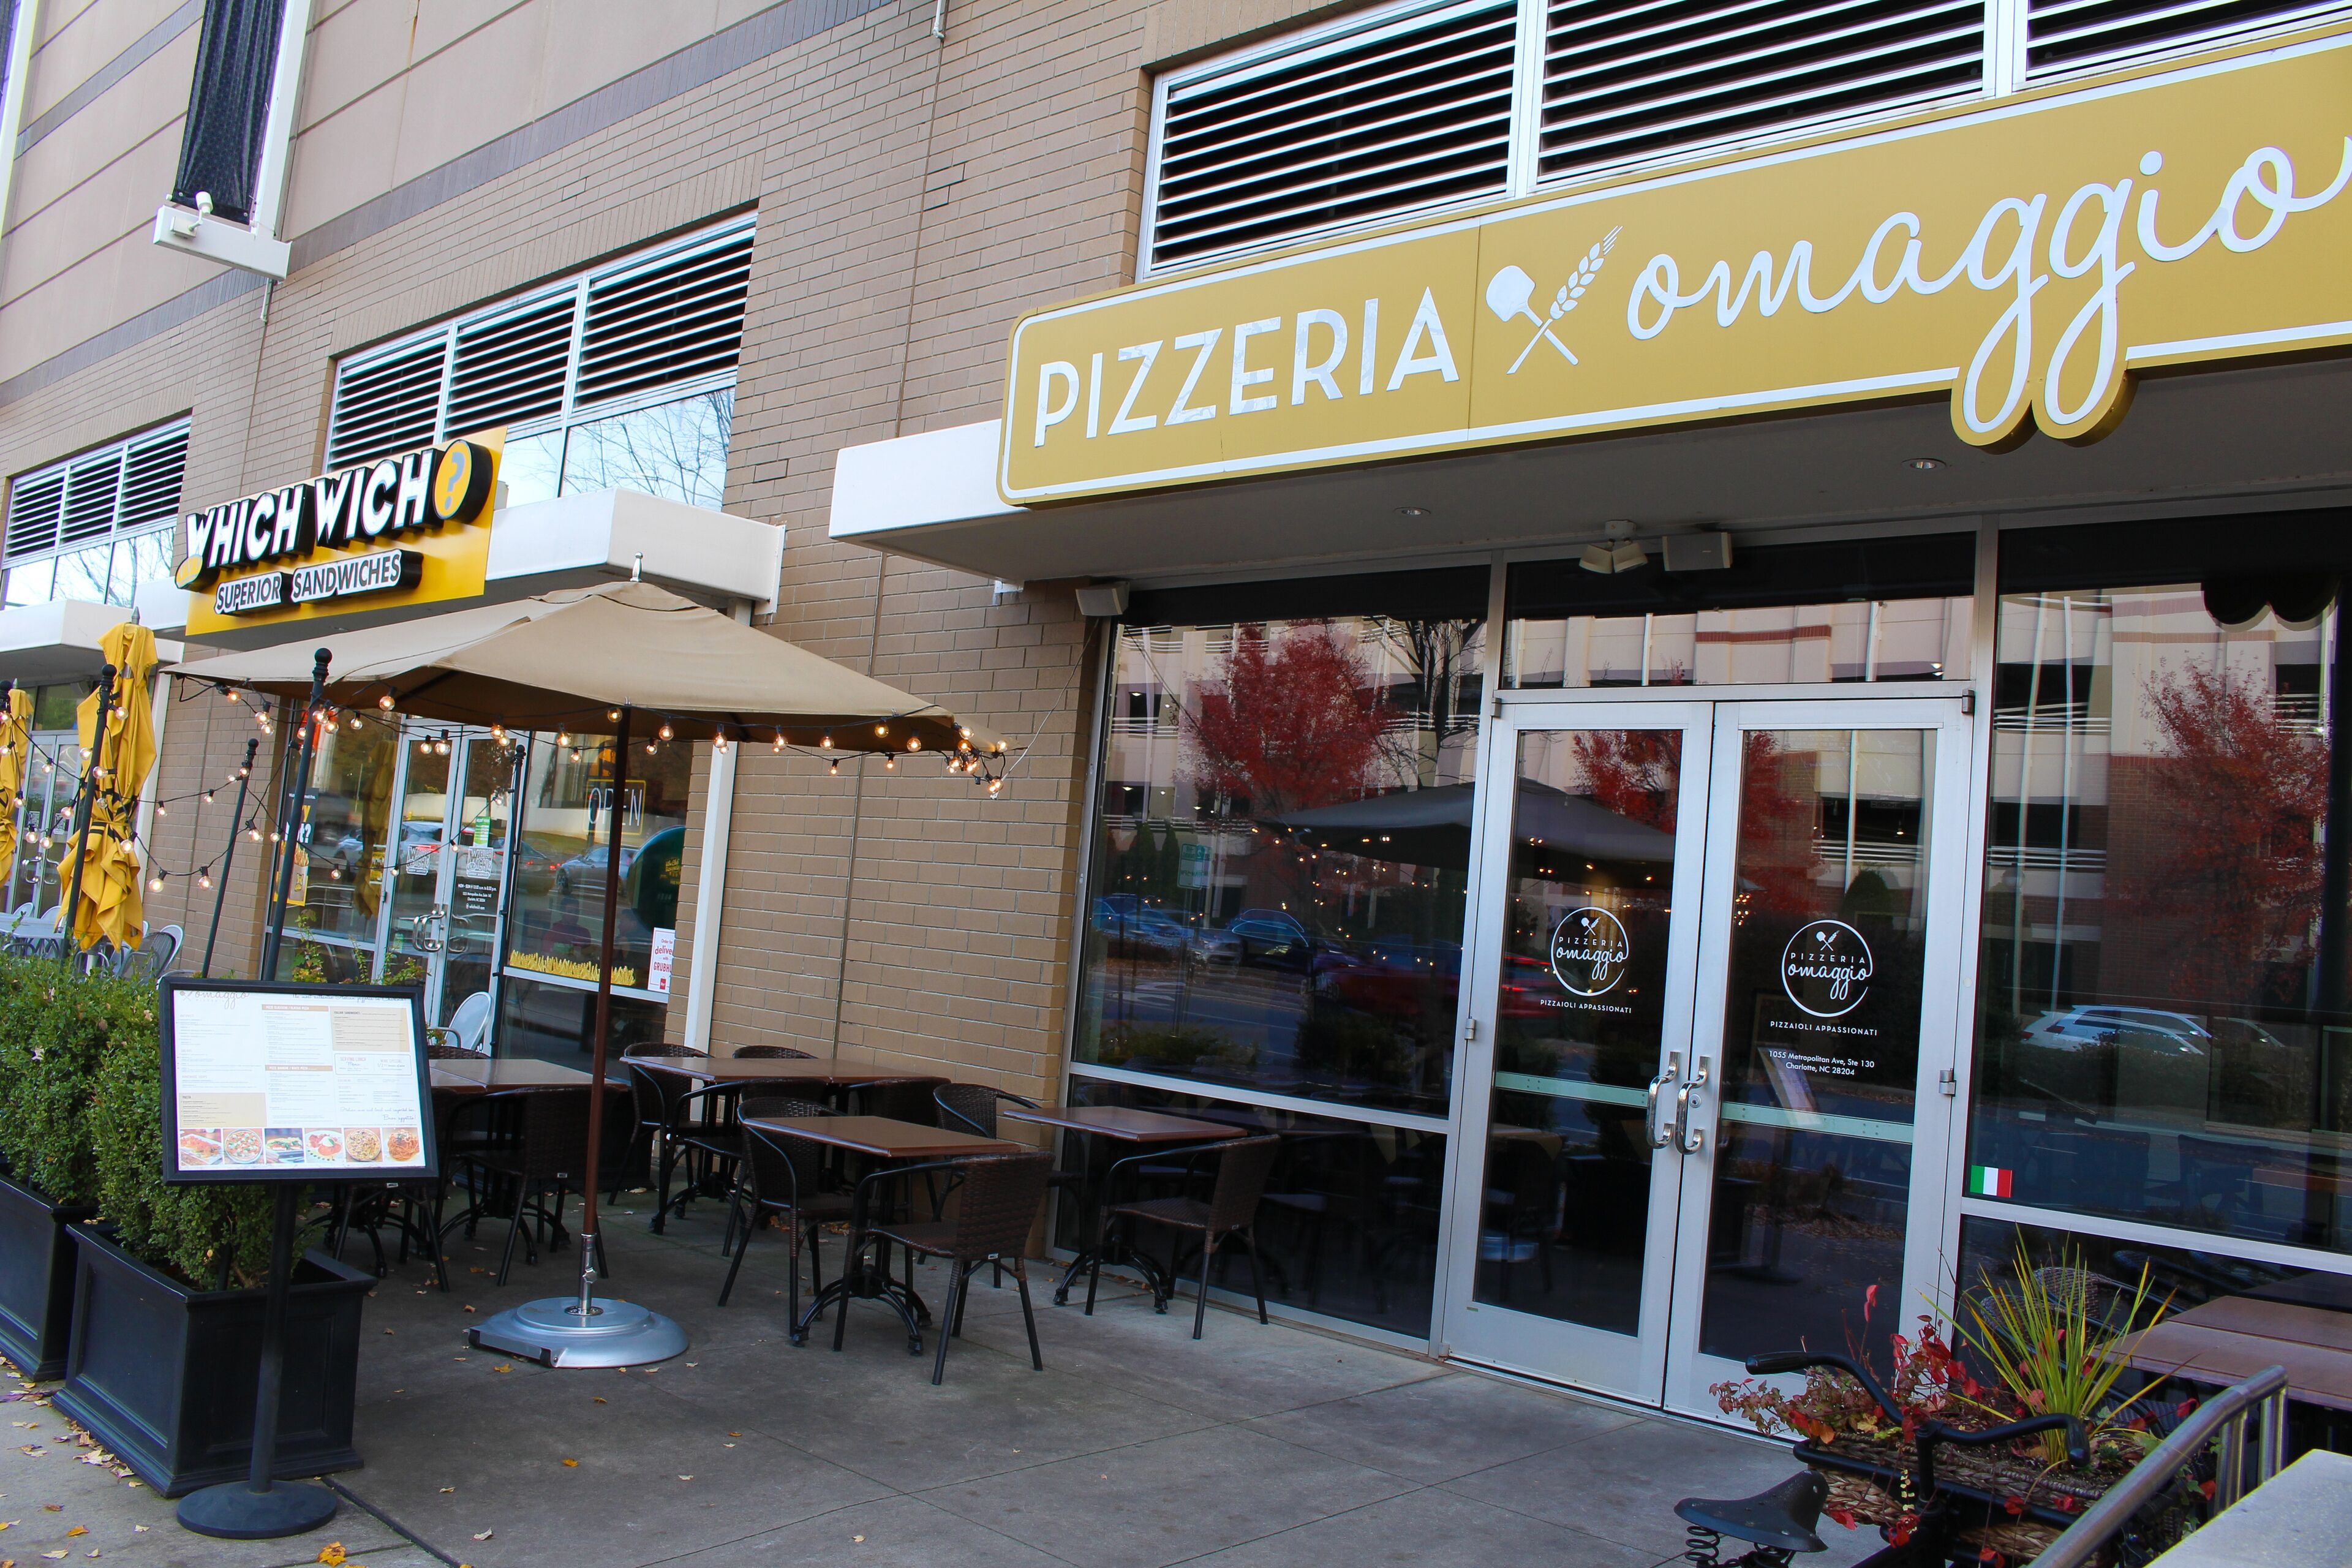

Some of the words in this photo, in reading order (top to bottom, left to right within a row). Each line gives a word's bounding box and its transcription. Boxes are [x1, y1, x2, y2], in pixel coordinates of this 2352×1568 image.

[1035, 286, 1460, 447] PIZZERIA
[1626, 136, 2352, 433] omaggio
[186, 483, 305, 568] WHICH
[217, 573, 281, 610] SUPERIOR
[293, 554, 401, 598] SANDWICHES
[589, 787, 643, 826] OPN
[655, 945, 673, 955] delive
[1559, 937, 1623, 948] PIZZERIA
[1556, 947, 1625, 981] omaggio
[1790, 952, 1865, 963] PIZZERIA
[1788, 963, 1870, 1000] omaggio
[1540, 1000, 1576, 1009] PIZZAIOLI
[1578, 1003, 1632, 1013] APPASSIONATI
[1770, 1021, 1812, 1031] PIZZAIOLI
[1815, 1025, 1877, 1036] APPASSIONATI
[1788, 1052, 1830, 1063] Metropolitan
[1831, 1057, 1845, 1066] Ave,
[1786, 1062, 1817, 1073] Charlotte,
[1832, 1066, 1855, 1076] 28204
